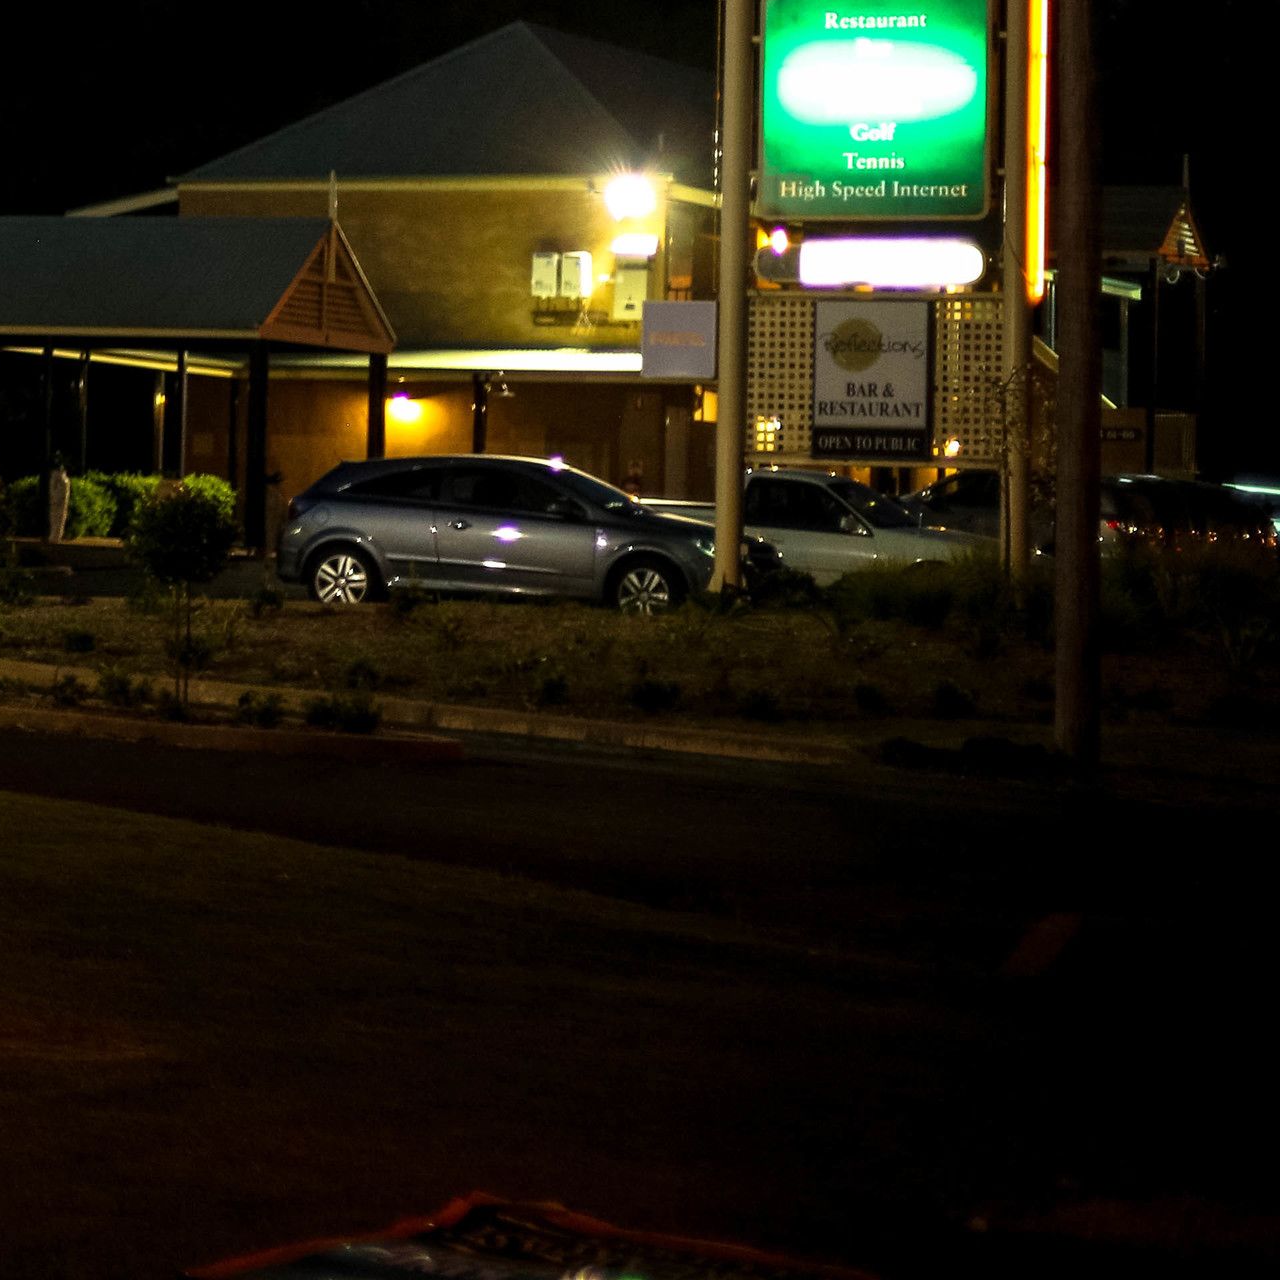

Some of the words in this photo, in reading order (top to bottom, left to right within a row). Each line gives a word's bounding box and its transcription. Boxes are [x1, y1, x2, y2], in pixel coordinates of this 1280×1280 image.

[824, 11, 928, 30] Restaurant
[848, 122, 897, 142] Golf
[842, 151, 906, 170] Tennis
[779, 180, 827, 201] High
[831, 180, 886, 201] Speed
[892, 180, 969, 198] Internet
[846, 382, 878, 398] BAR
[882, 382, 895, 398] &
[818, 400, 923, 418] RESTAURANT
[818, 434, 852, 450] OPEN
[855, 435, 873, 450] TO
[875, 435, 921, 452] PUBLIC
